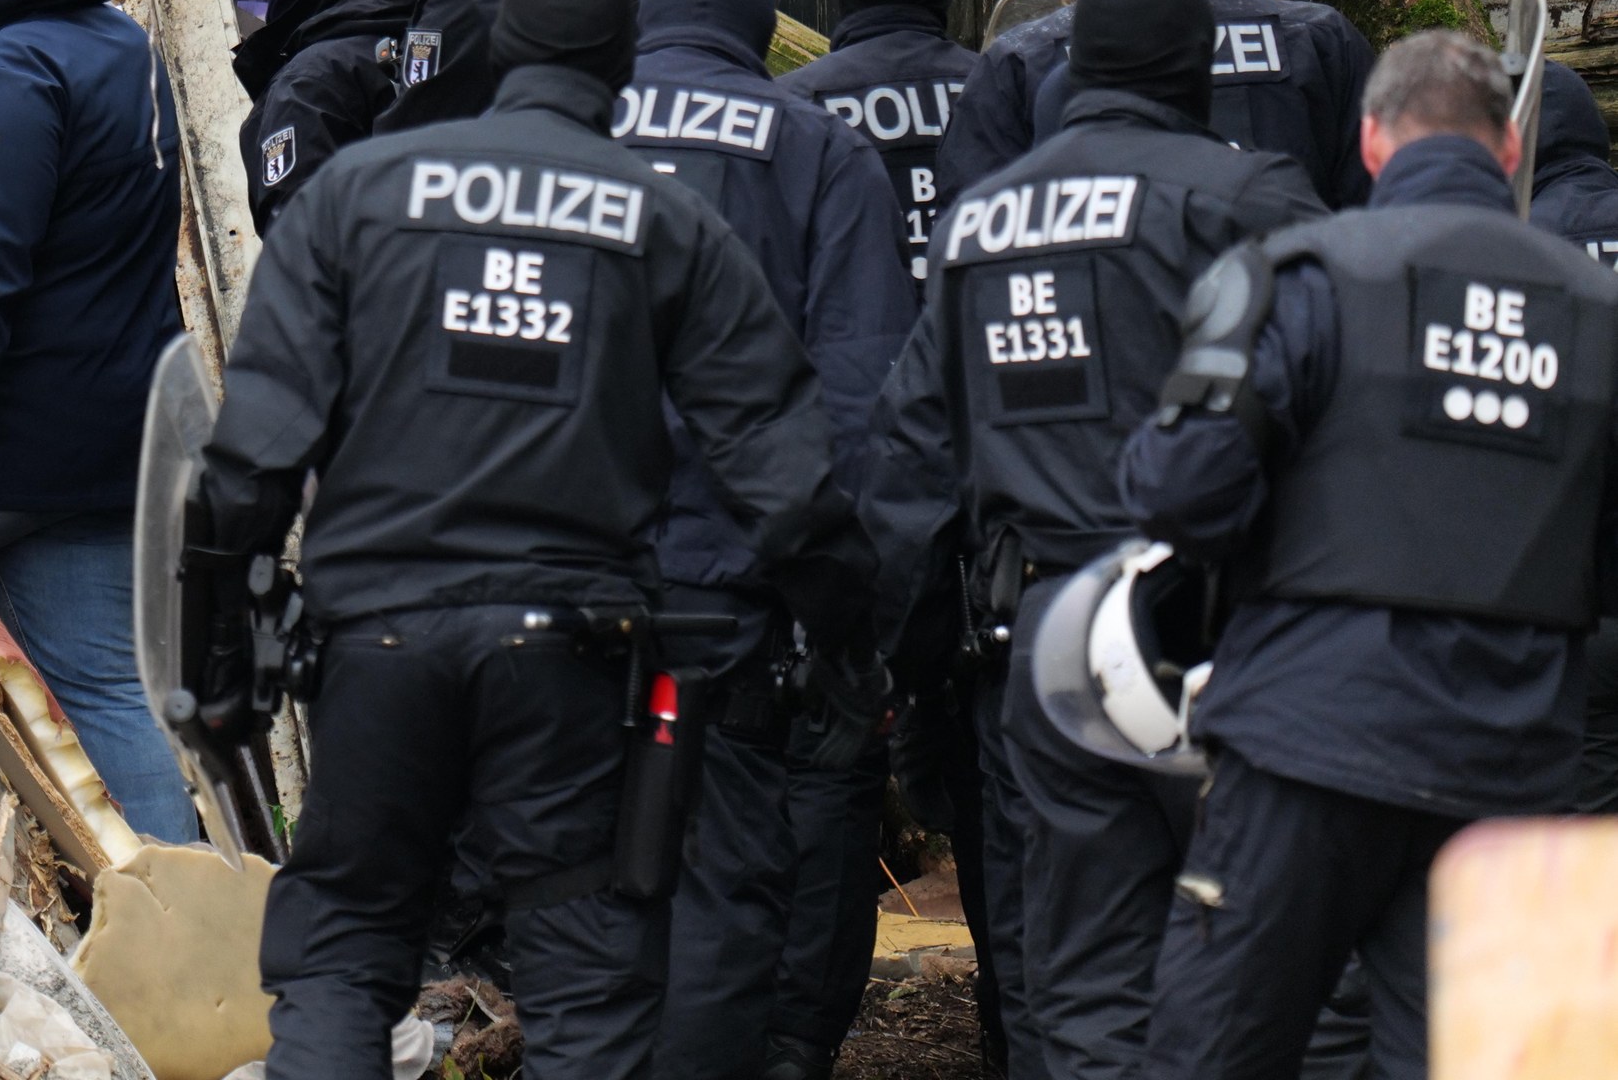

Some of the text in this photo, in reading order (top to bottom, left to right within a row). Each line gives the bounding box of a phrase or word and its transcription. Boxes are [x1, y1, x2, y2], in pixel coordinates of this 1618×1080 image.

[408, 33, 440, 46] POLIZEI
[610, 87, 775, 151] OLIZEI
[824, 82, 965, 140] POLI
[407, 160, 645, 245] POLIZEI
[944, 175, 1139, 262] POLIZEI
[482, 248, 545, 295] BE
[1008, 271, 1057, 316] BE
[442, 292, 573, 344] E1332
[1463, 283, 1527, 336] BE
[985, 317, 1091, 365] E1331
[1424, 322, 1559, 390] E1200
